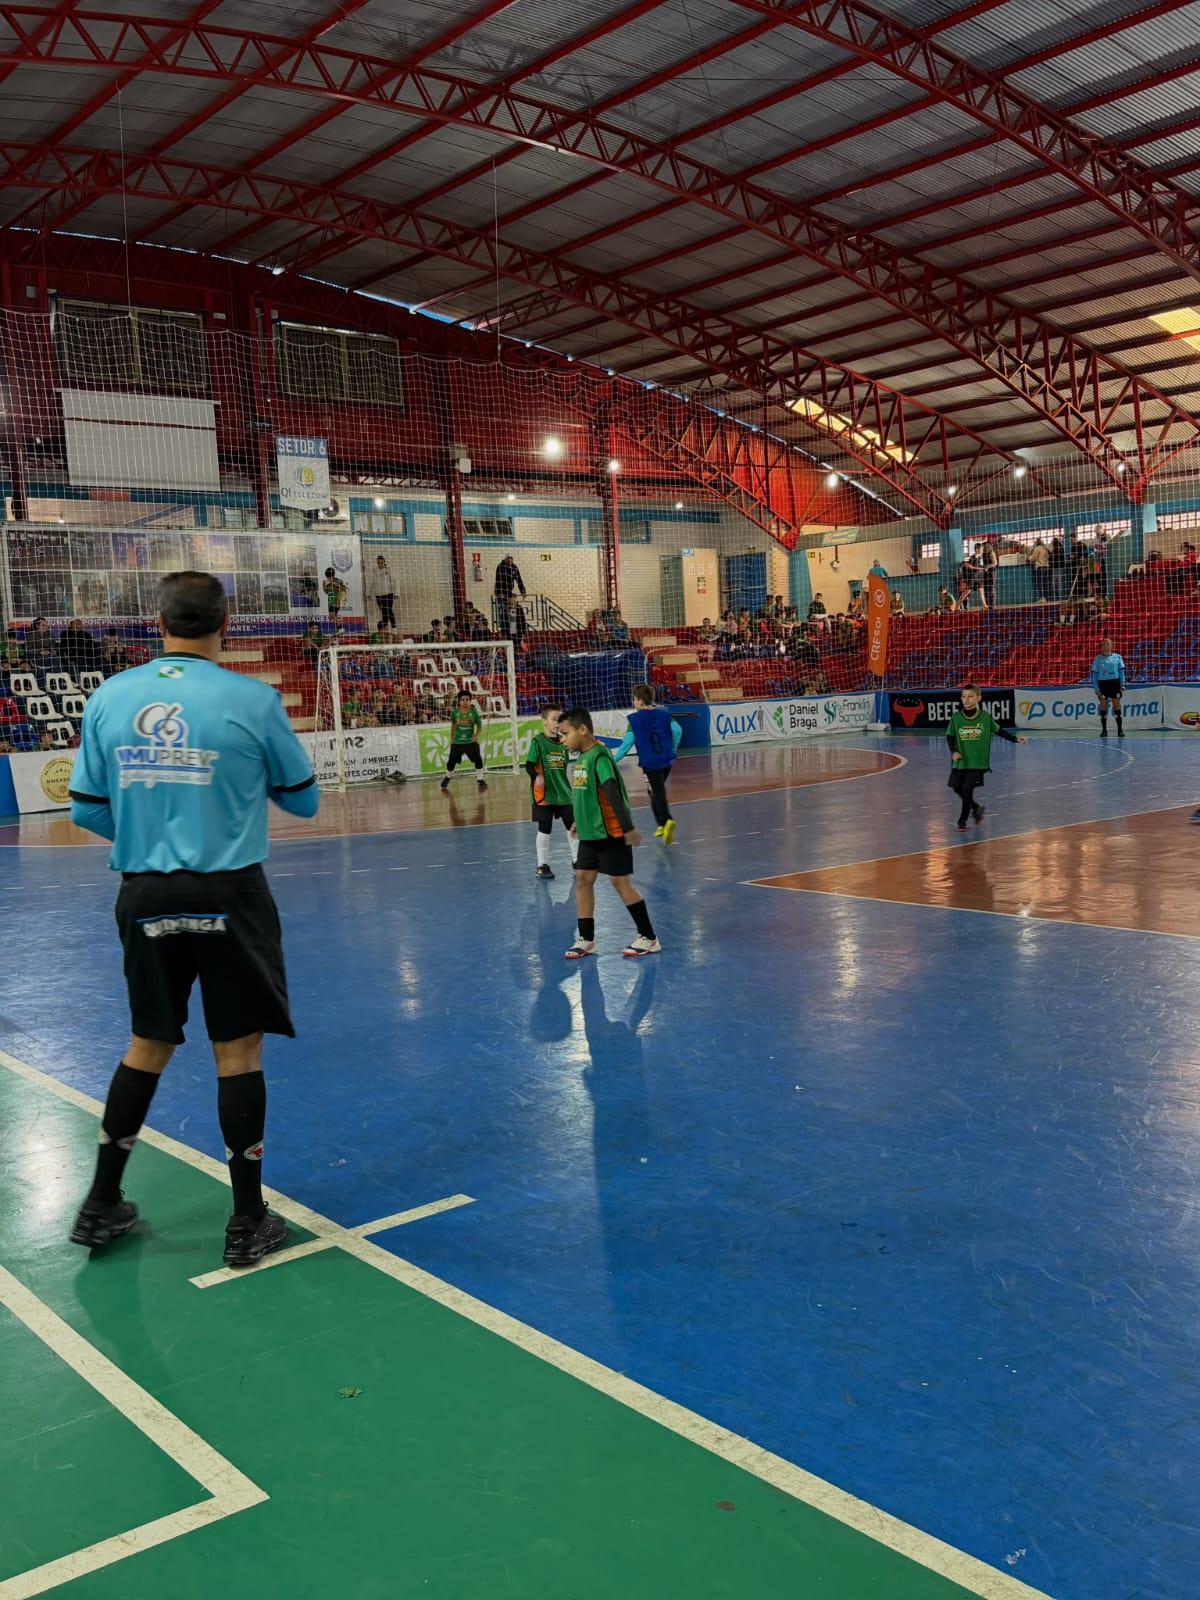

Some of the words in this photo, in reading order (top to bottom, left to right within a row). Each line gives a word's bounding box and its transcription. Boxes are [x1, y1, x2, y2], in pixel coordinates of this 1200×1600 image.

[278, 438, 315, 454] SETOR
[319, 440, 326, 455] 6
[789, 702, 819, 715] Daniel
[980, 700, 1010, 720] NCH
[1052, 701, 1159, 720] Coperma
[790, 716, 818, 730] Braga
[368, 755, 398, 764] MEINERZ
